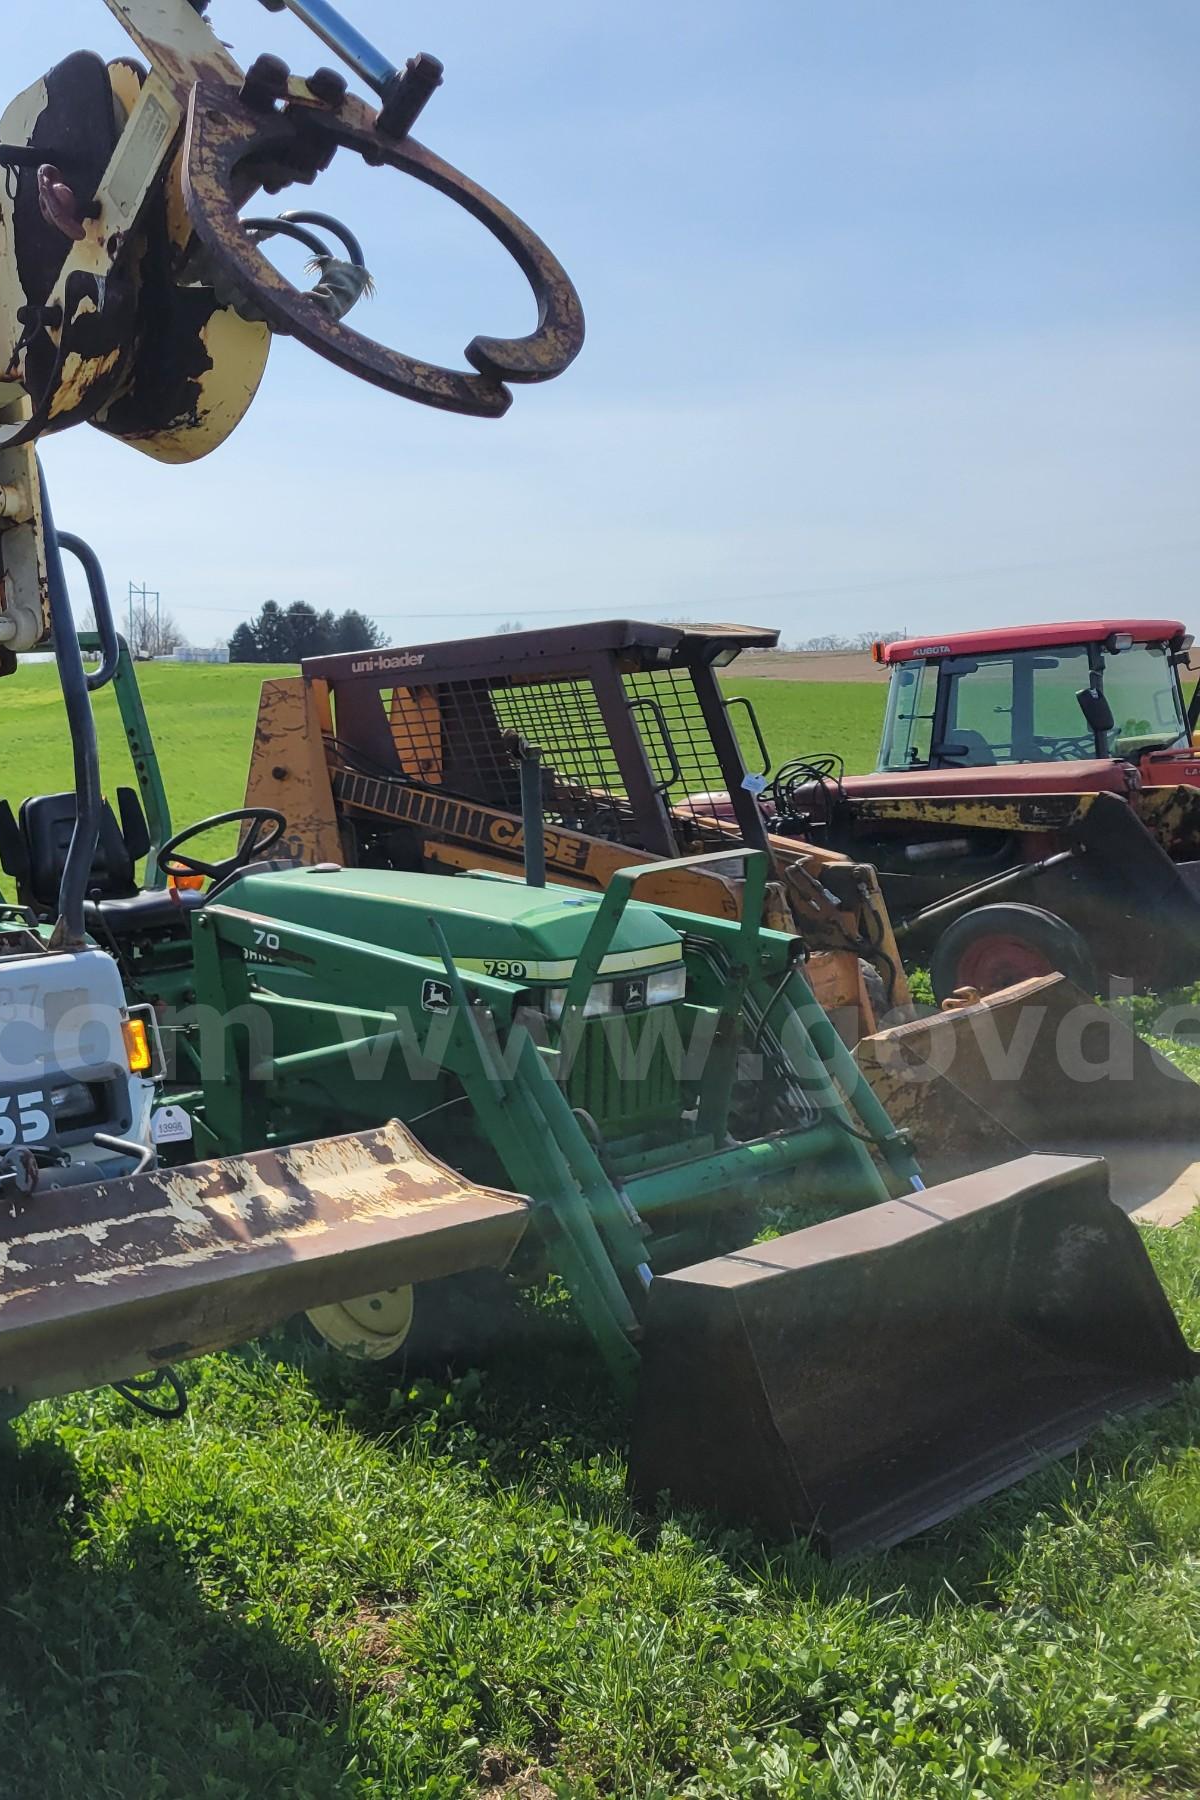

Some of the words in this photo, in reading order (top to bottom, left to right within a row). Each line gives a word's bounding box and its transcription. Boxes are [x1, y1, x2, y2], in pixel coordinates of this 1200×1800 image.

[913, 646, 951, 656] KUBOTA
[351, 652, 425, 673] uni-loader
[1185, 768, 1200, 776] LA
[484, 961, 527, 979] 790
